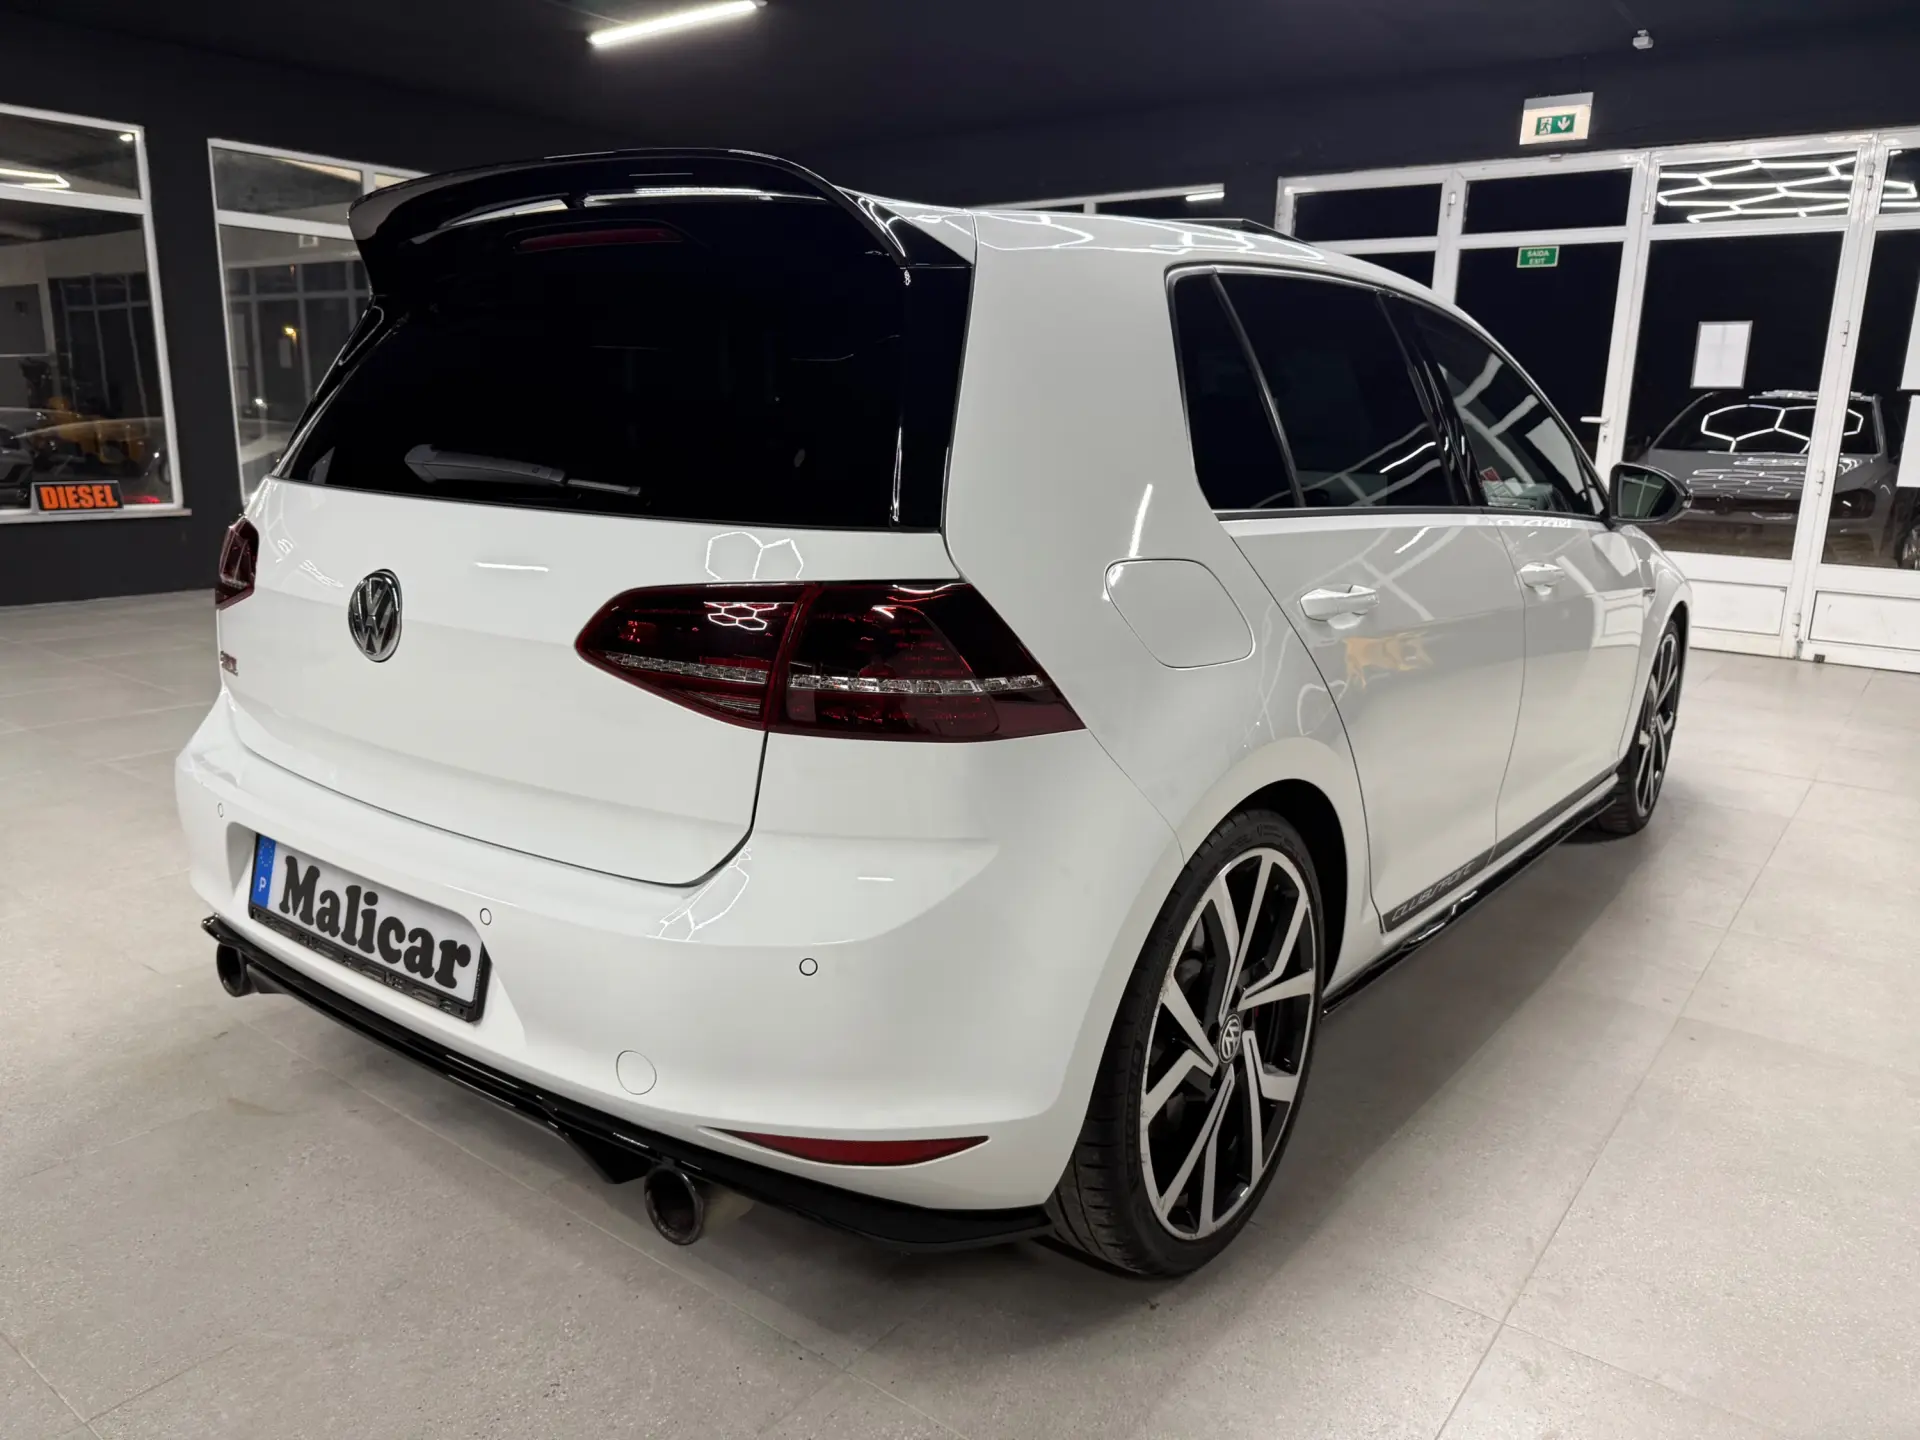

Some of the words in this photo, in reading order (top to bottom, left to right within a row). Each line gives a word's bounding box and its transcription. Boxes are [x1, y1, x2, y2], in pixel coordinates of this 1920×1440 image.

[40, 484, 118, 510] DIESEL
[348, 568, 402, 663] VW
[258, 876, 267, 893] P
[279, 855, 472, 989] Malicar
